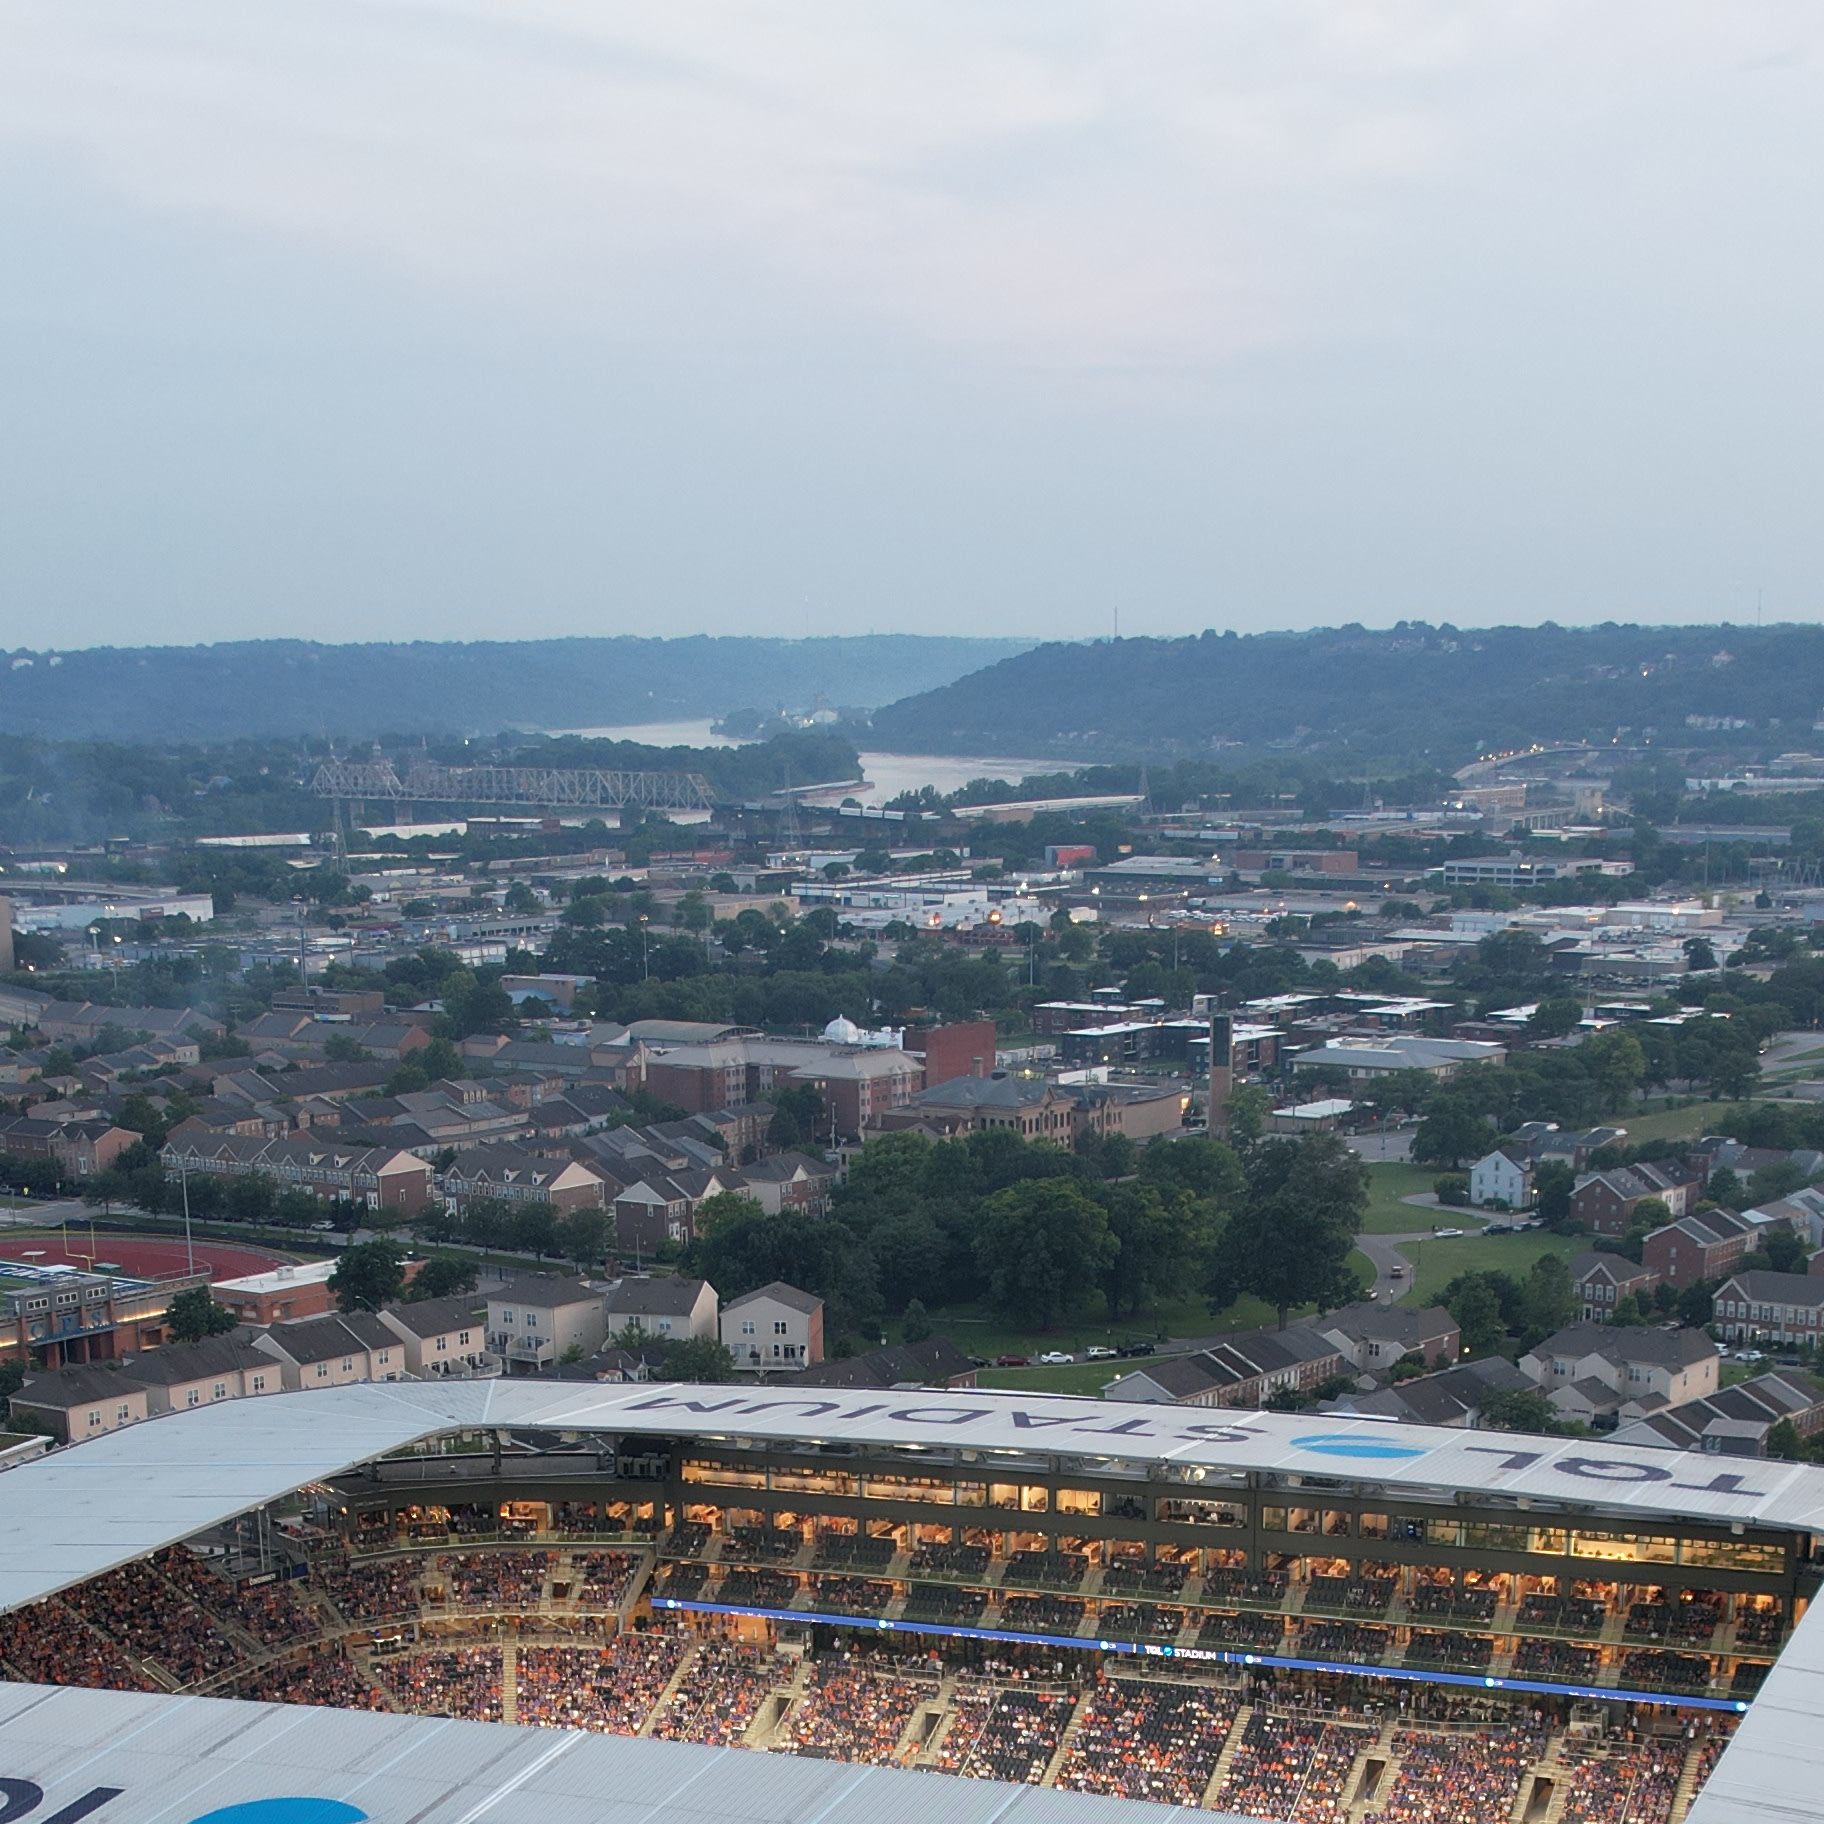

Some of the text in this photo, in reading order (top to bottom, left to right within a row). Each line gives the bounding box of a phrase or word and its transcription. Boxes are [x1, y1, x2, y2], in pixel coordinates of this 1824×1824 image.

[623, 1396, 1766, 1497] TQL STADIUM
[1174, 1648, 1216, 1660] STADIUM
